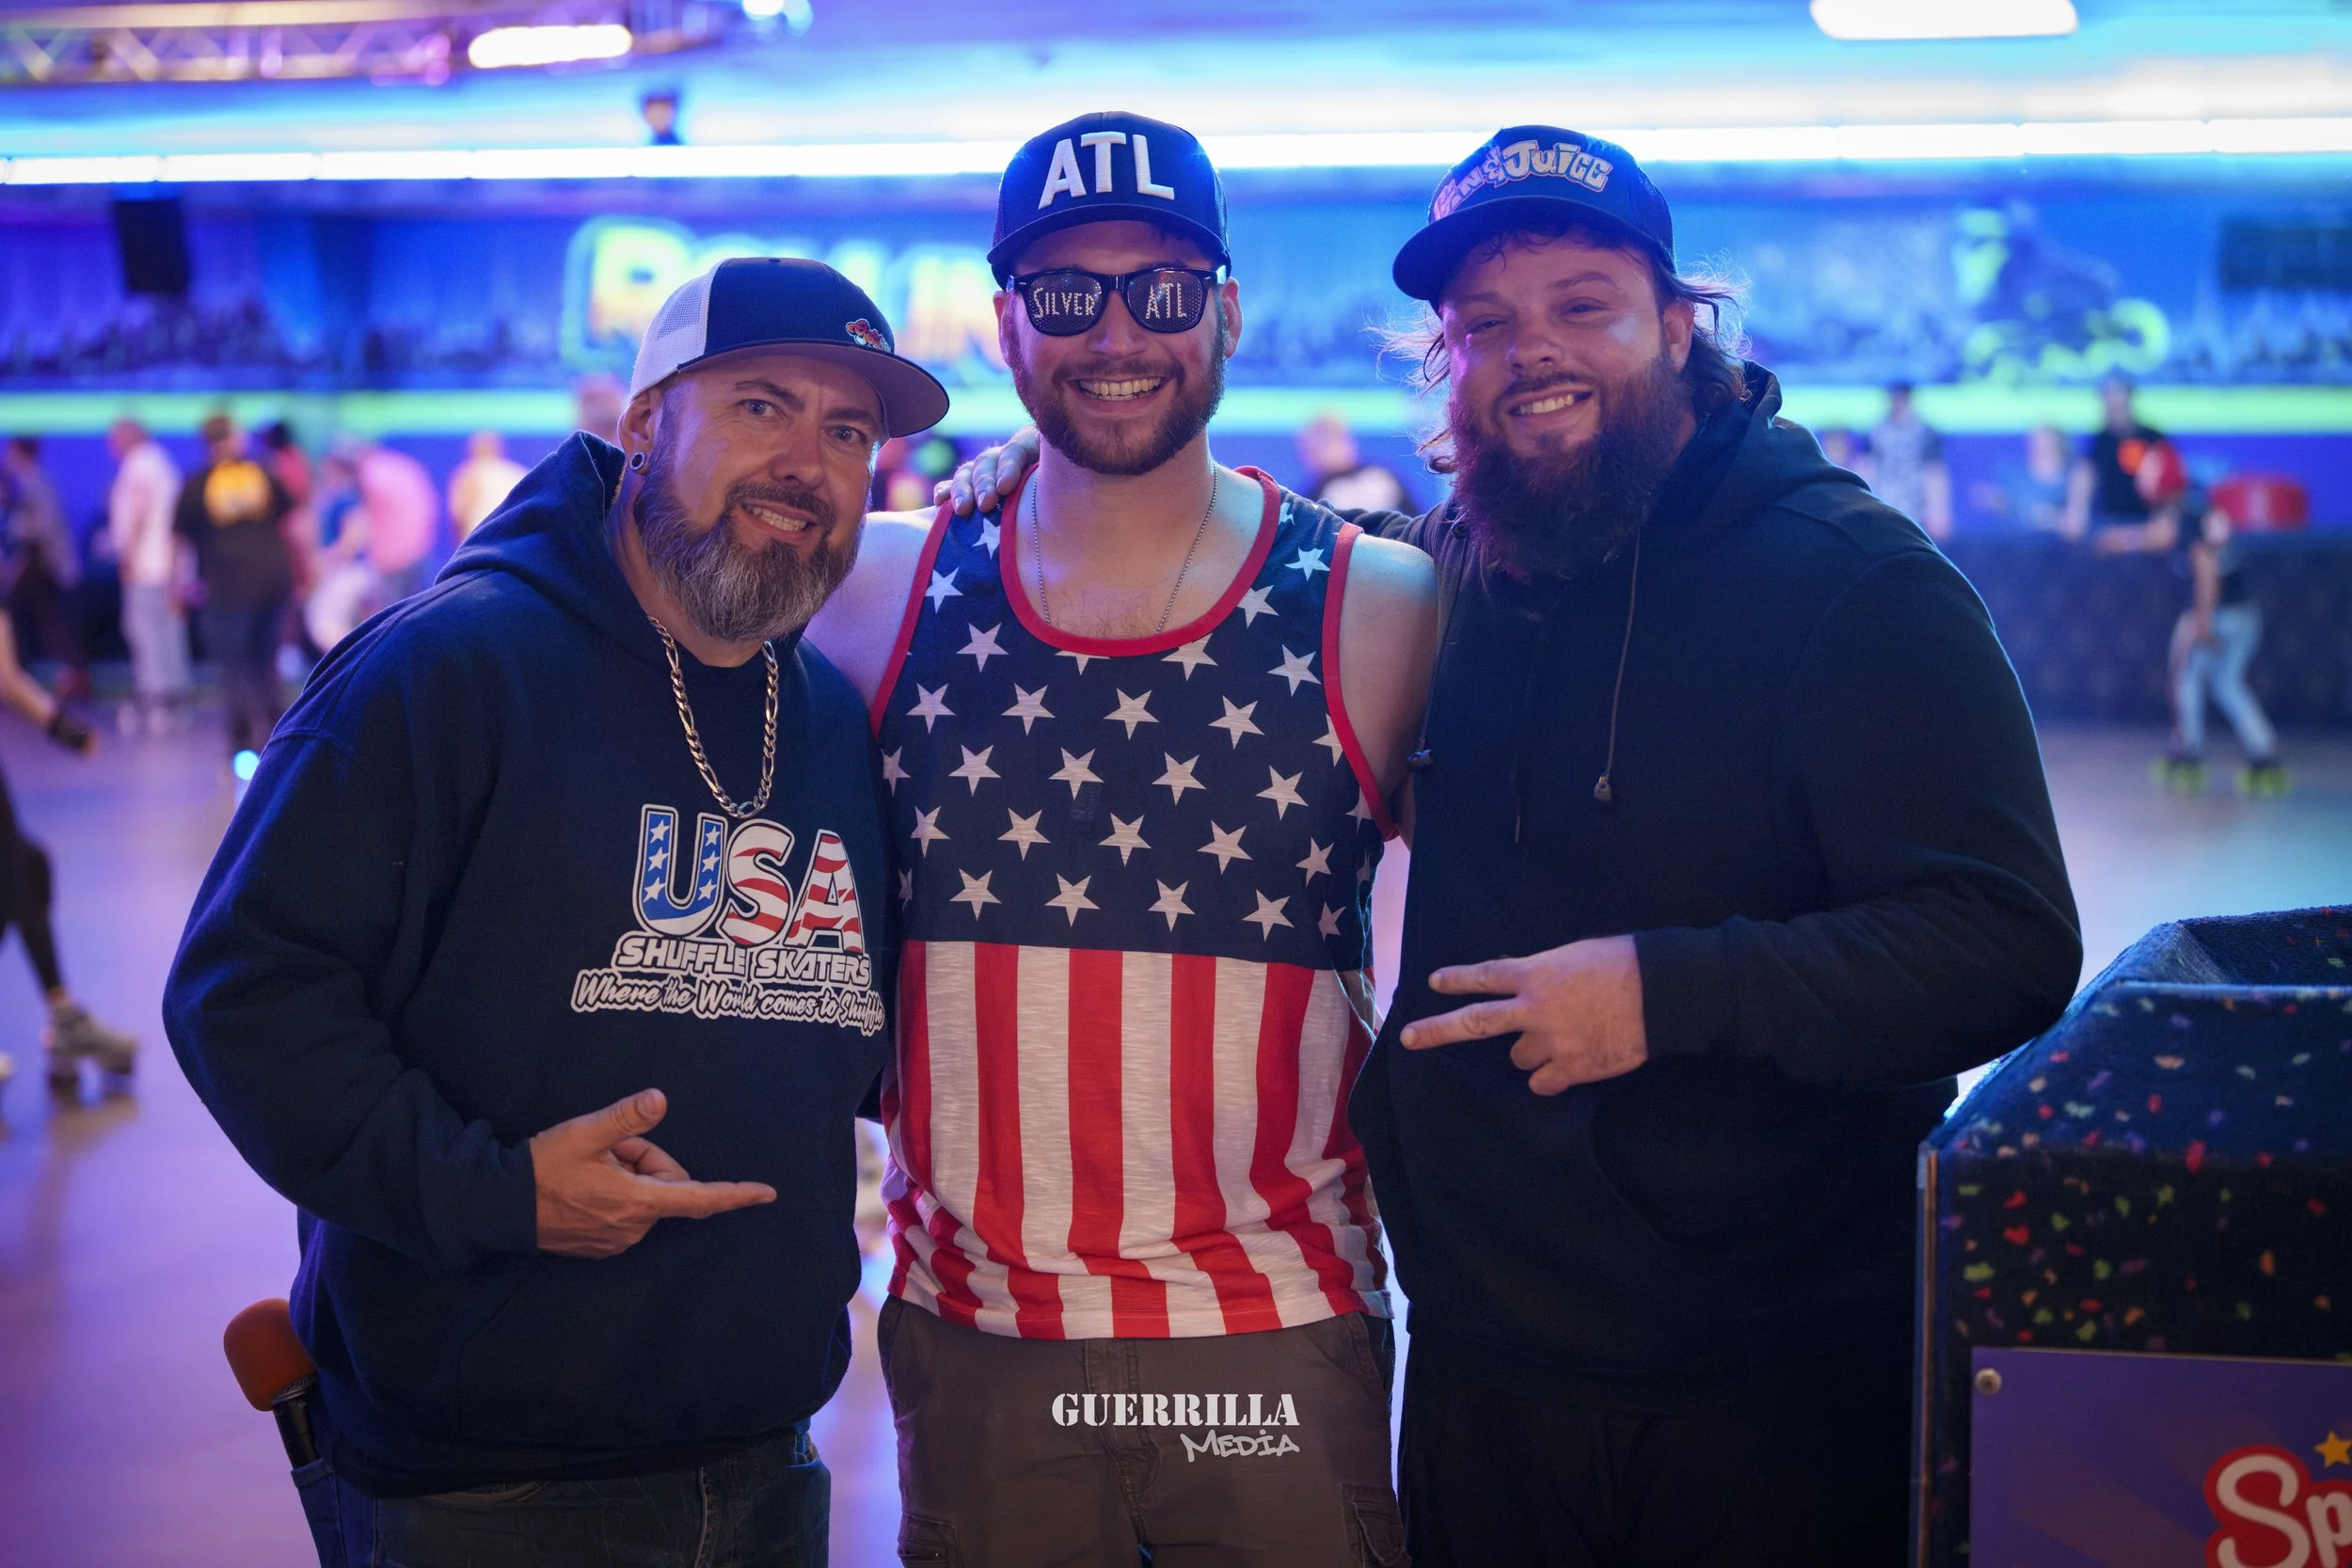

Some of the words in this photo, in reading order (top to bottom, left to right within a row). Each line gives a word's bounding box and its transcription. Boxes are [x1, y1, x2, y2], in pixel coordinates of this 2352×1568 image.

[1038, 131, 1175, 209] ATL
[1033, 286, 1095, 319] SILVER
[1145, 282, 1187, 320] ATL
[633, 804, 864, 955] USA
[618, 936, 746, 976] SHUFFLE
[755, 948, 869, 987] SKATERS
[575, 973, 660, 1007] Where
[661, 976, 695, 1007] the
[697, 981, 758, 1014] World
[761, 993, 817, 1018] comes
[818, 988, 838, 1018] to
[839, 990, 884, 1032] Shuffle
